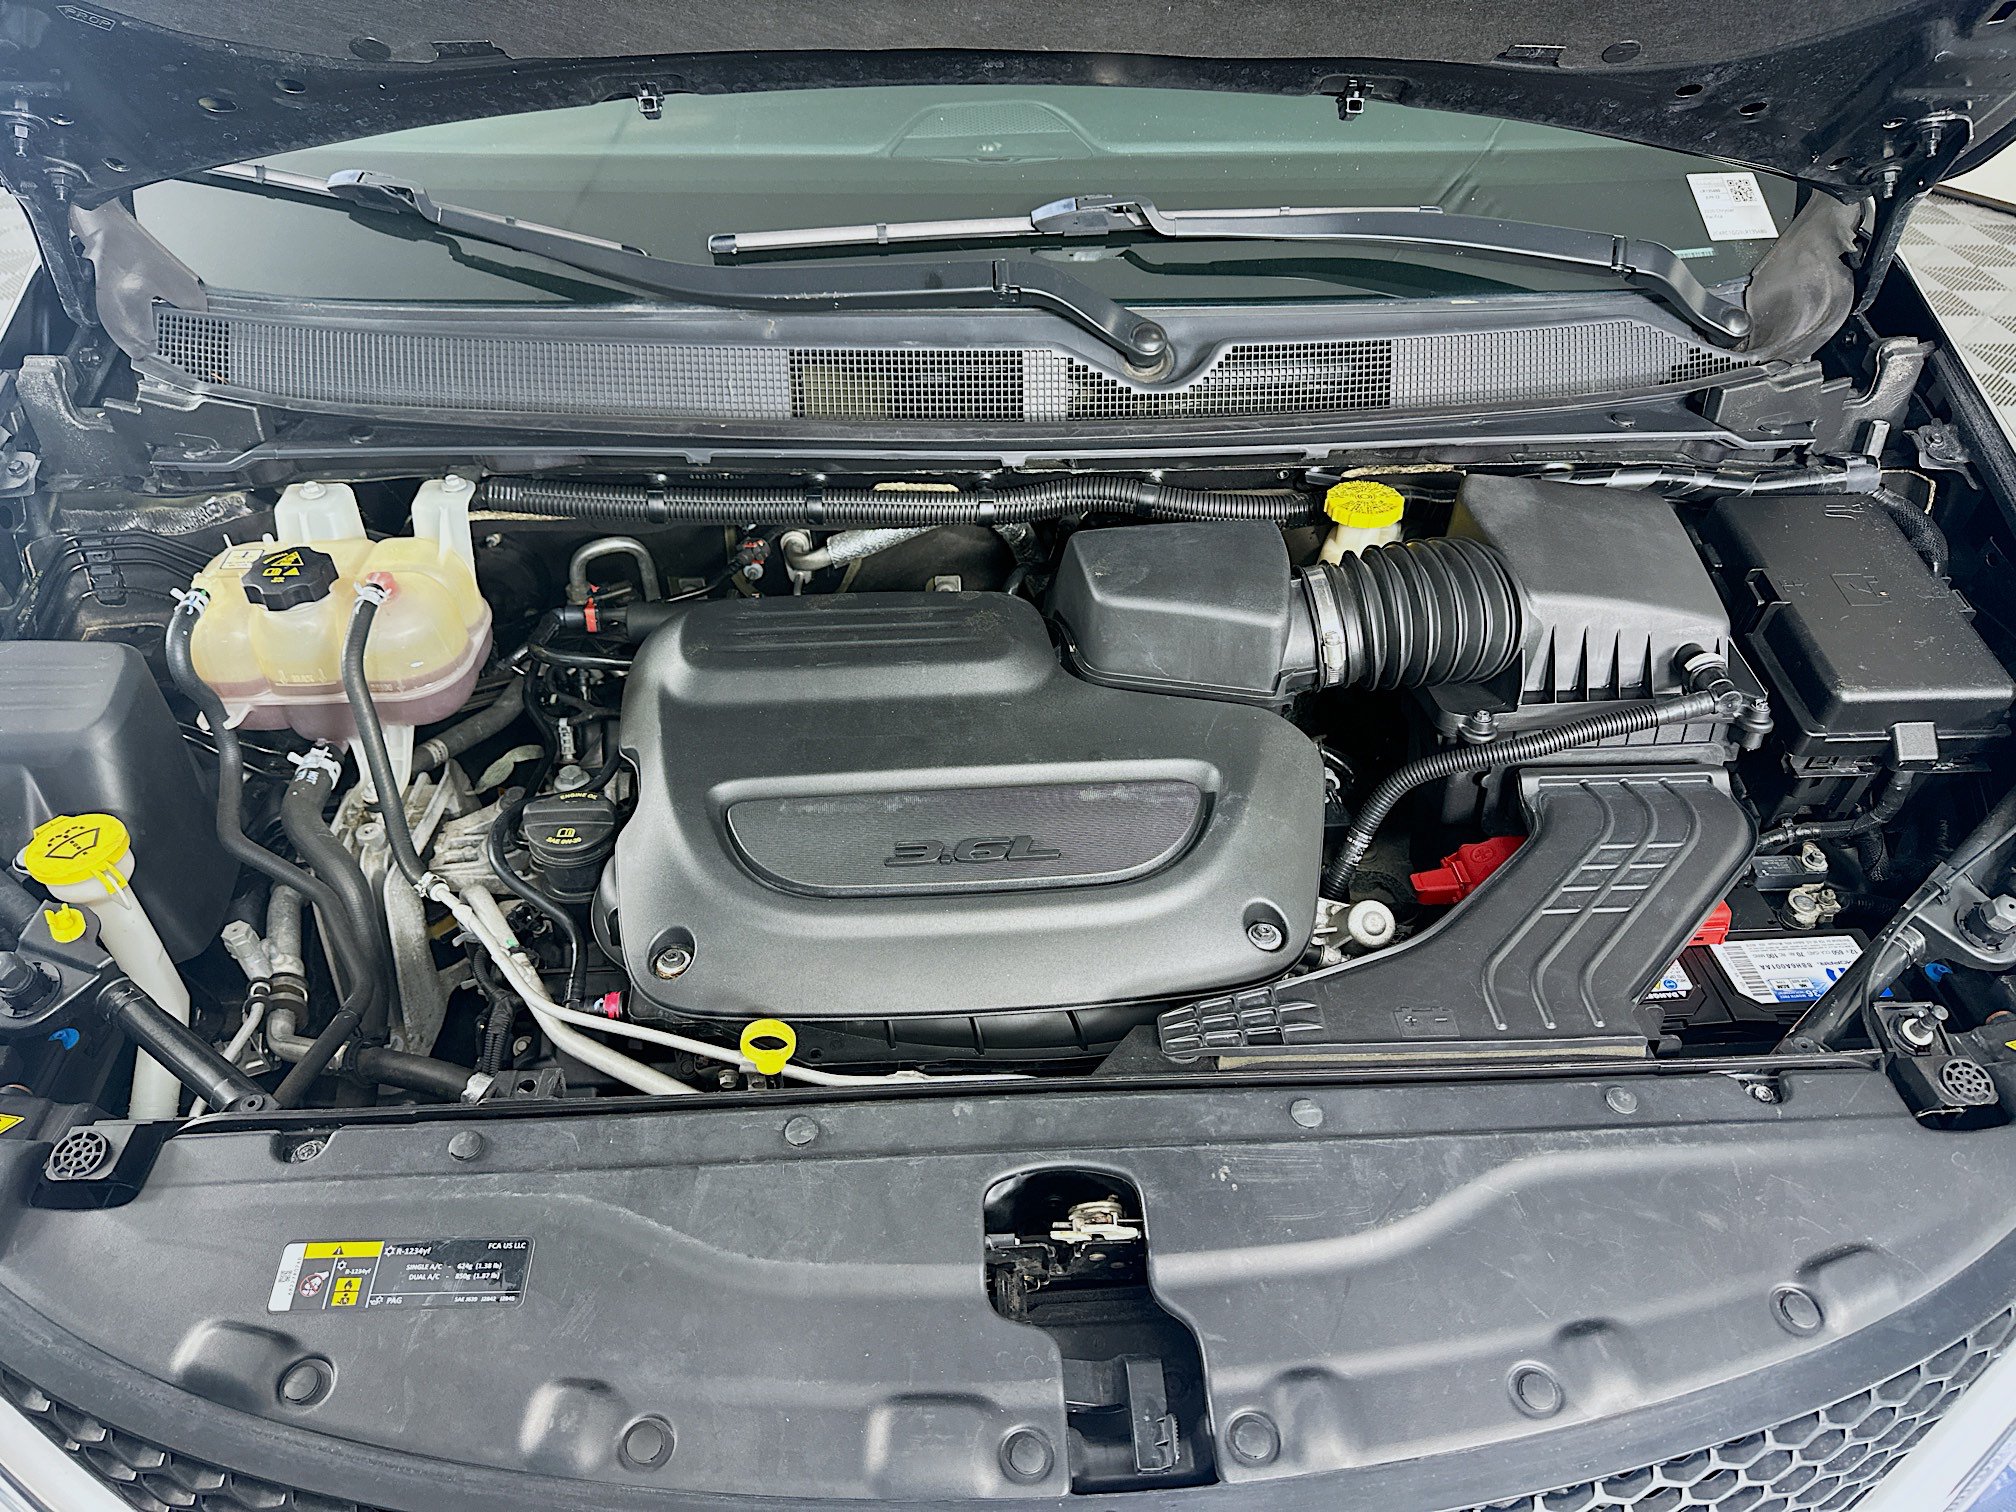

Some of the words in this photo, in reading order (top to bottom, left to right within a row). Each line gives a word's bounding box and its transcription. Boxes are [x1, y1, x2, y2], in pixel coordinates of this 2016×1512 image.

[65, 7, 111, 26] PROP
[560, 792, 587, 800] ENGINE
[884, 835, 1062, 867] 3.6L
[487, 1242, 502, 1250] FCA
[396, 1246, 432, 1256] R-1234yf
[405, 1263, 429, 1271] SINGLE
[429, 1262, 443, 1271] A/C
[408, 1273, 427, 1281] DUAL
[426, 1273, 441, 1281] A/C
[386, 1296, 403, 1305] PAG
